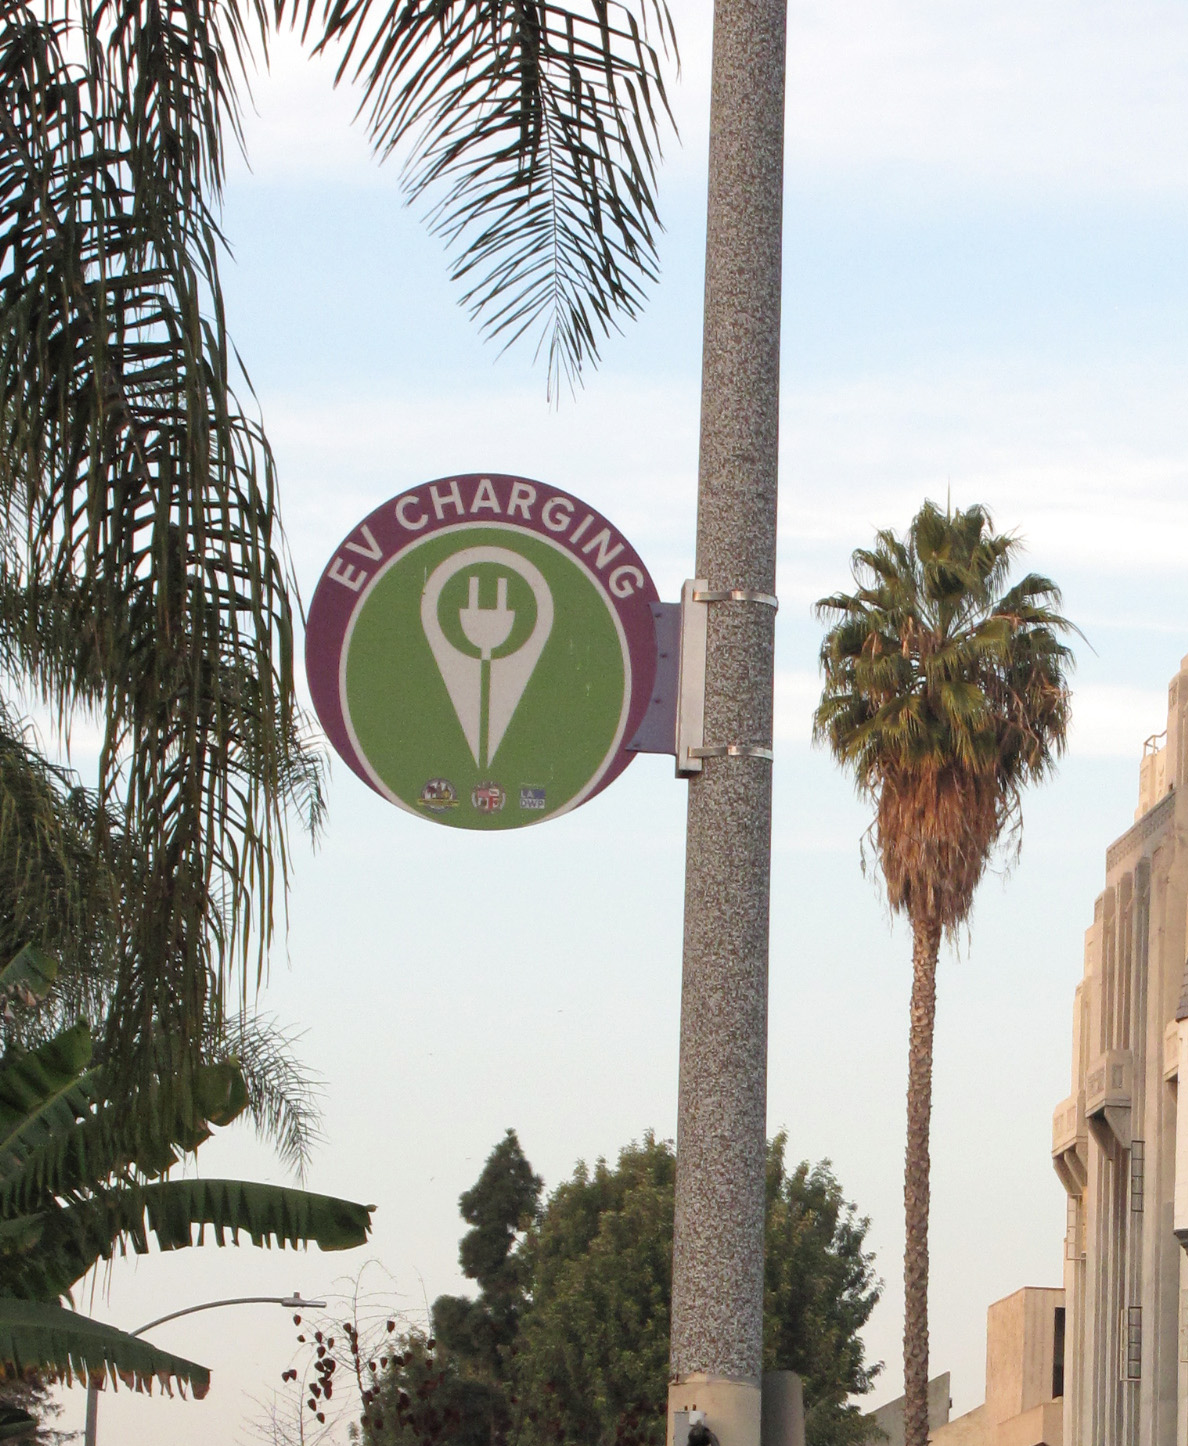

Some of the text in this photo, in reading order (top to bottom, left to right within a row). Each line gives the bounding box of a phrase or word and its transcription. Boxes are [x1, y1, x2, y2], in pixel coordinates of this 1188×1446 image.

[327, 478, 645, 599] EV CHARGING
[521, 790, 533, 798] LA
[520, 799, 544, 808] DWP
